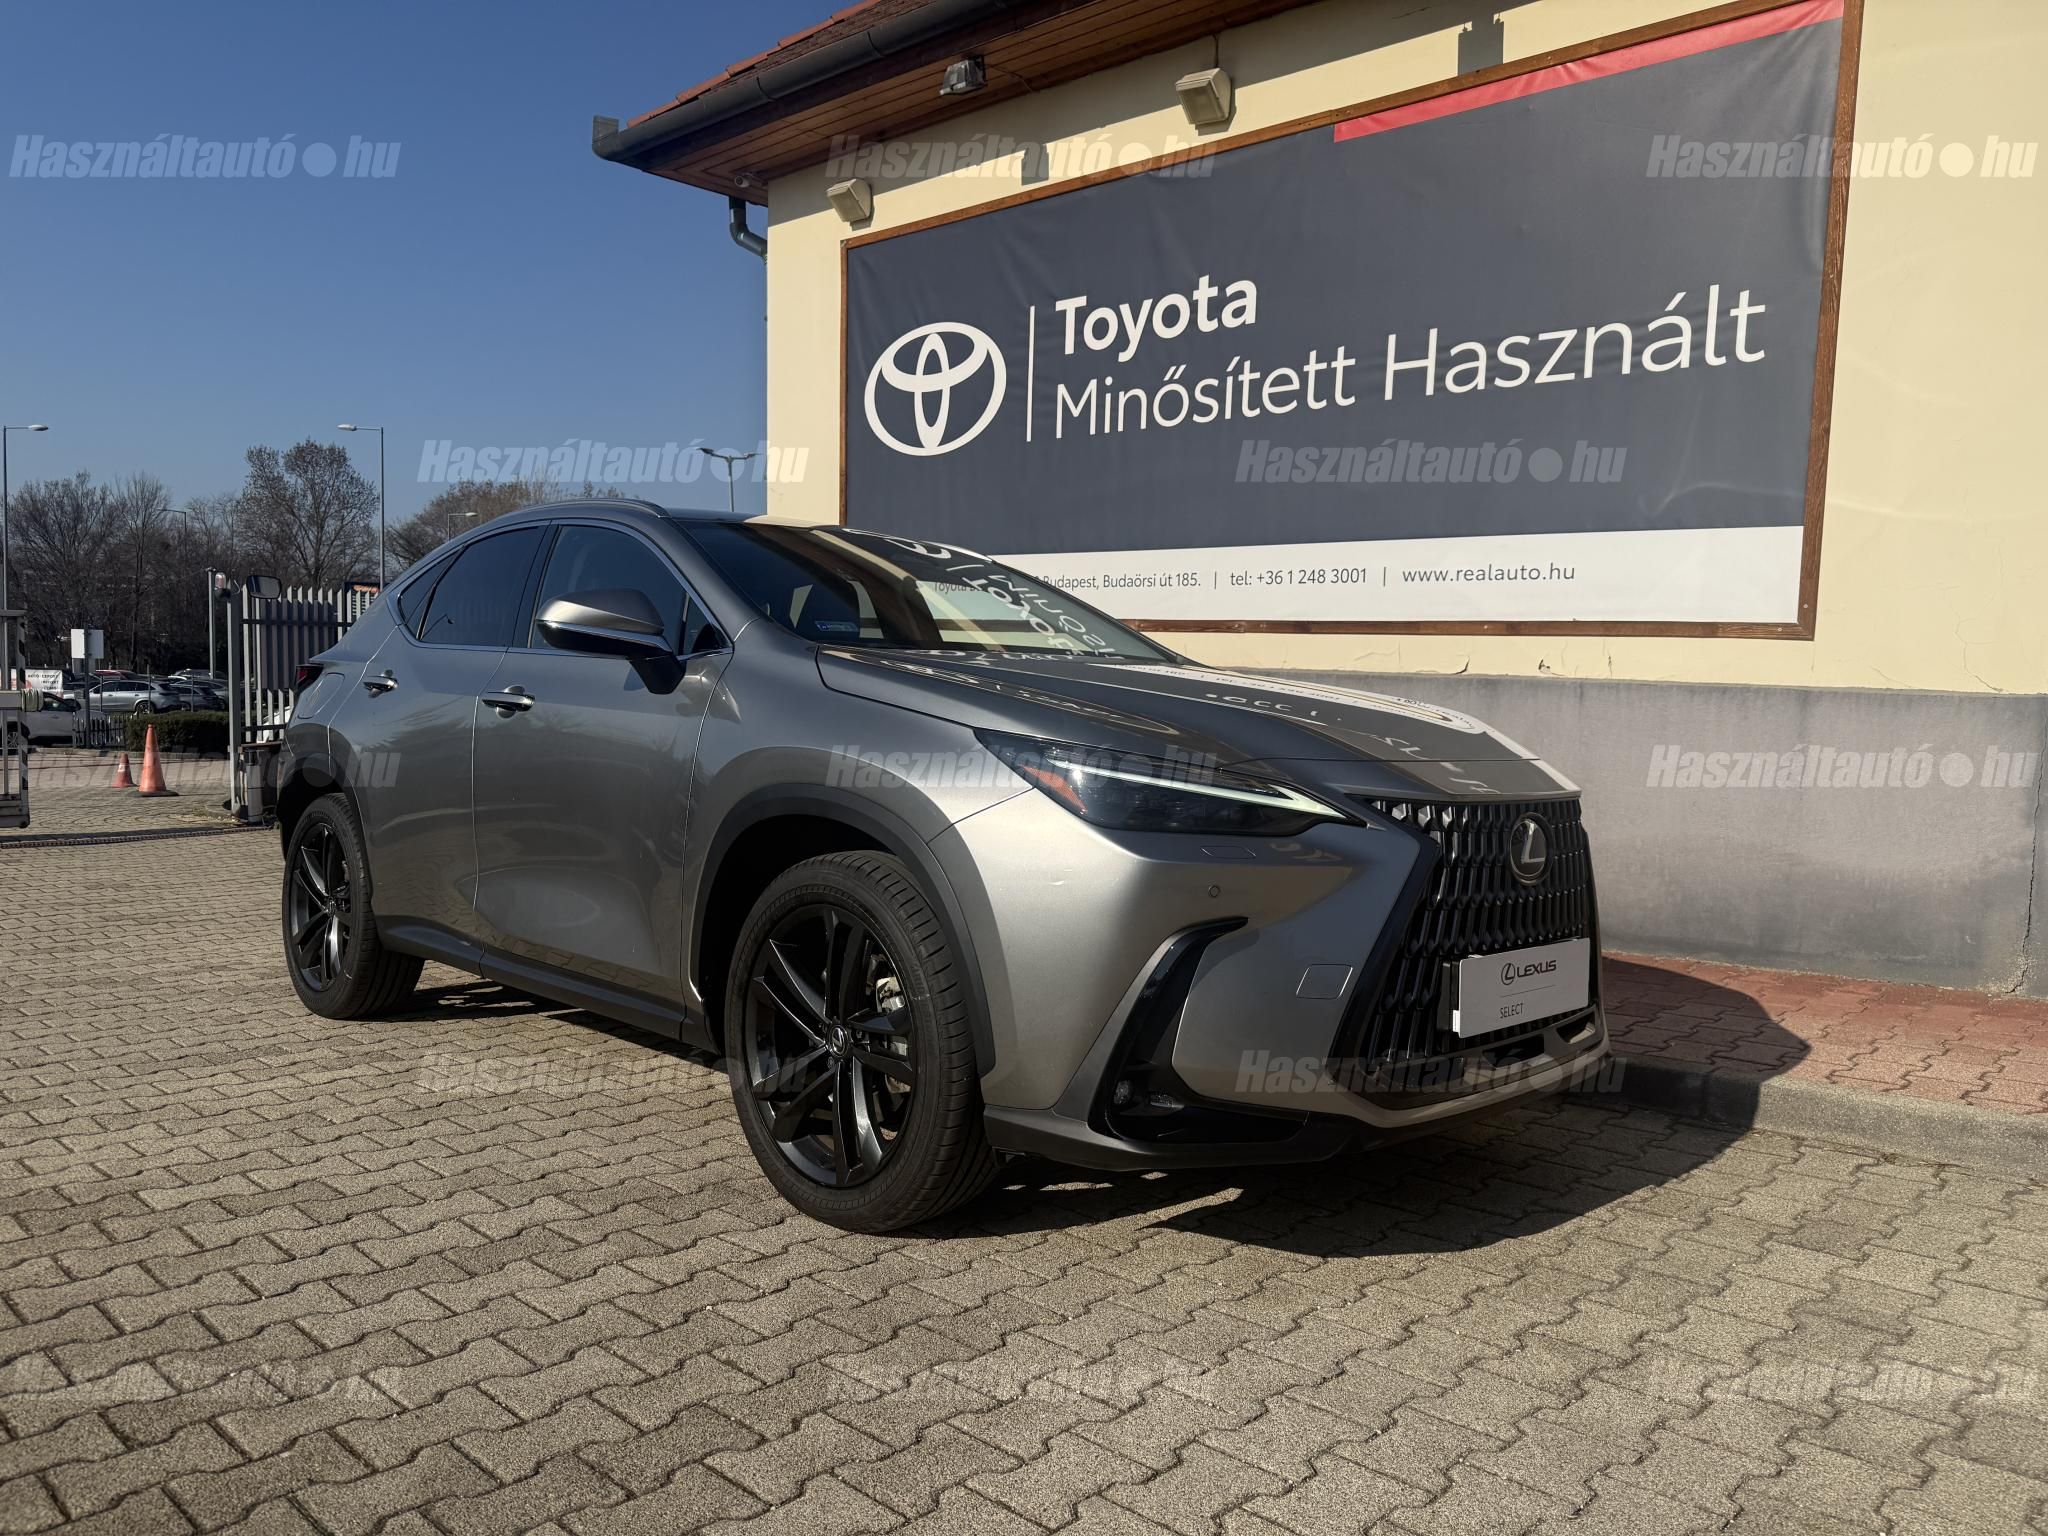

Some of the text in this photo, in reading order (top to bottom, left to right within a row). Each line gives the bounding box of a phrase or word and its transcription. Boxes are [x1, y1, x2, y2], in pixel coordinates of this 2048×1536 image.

[1056, 275, 1257, 362] Toyota
[1055, 284, 1767, 439] Minősített Használt
[1103, 573, 1157, 588] Budaörsi
[1159, 572, 1173, 588] út
[1176, 572, 1202, 587] 185.
[1230, 570, 1253, 586] tel:
[1256, 570, 1284, 586] +36
[1287, 570, 1293, 585] 1
[1298, 569, 1326, 585] 248
[1330, 568, 1367, 584] 3001
[1402, 562, 1576, 583] www.realauto.hu
[1517, 960, 1557, 978] LEXUS
[1499, 1002, 1524, 1019] SELECT
